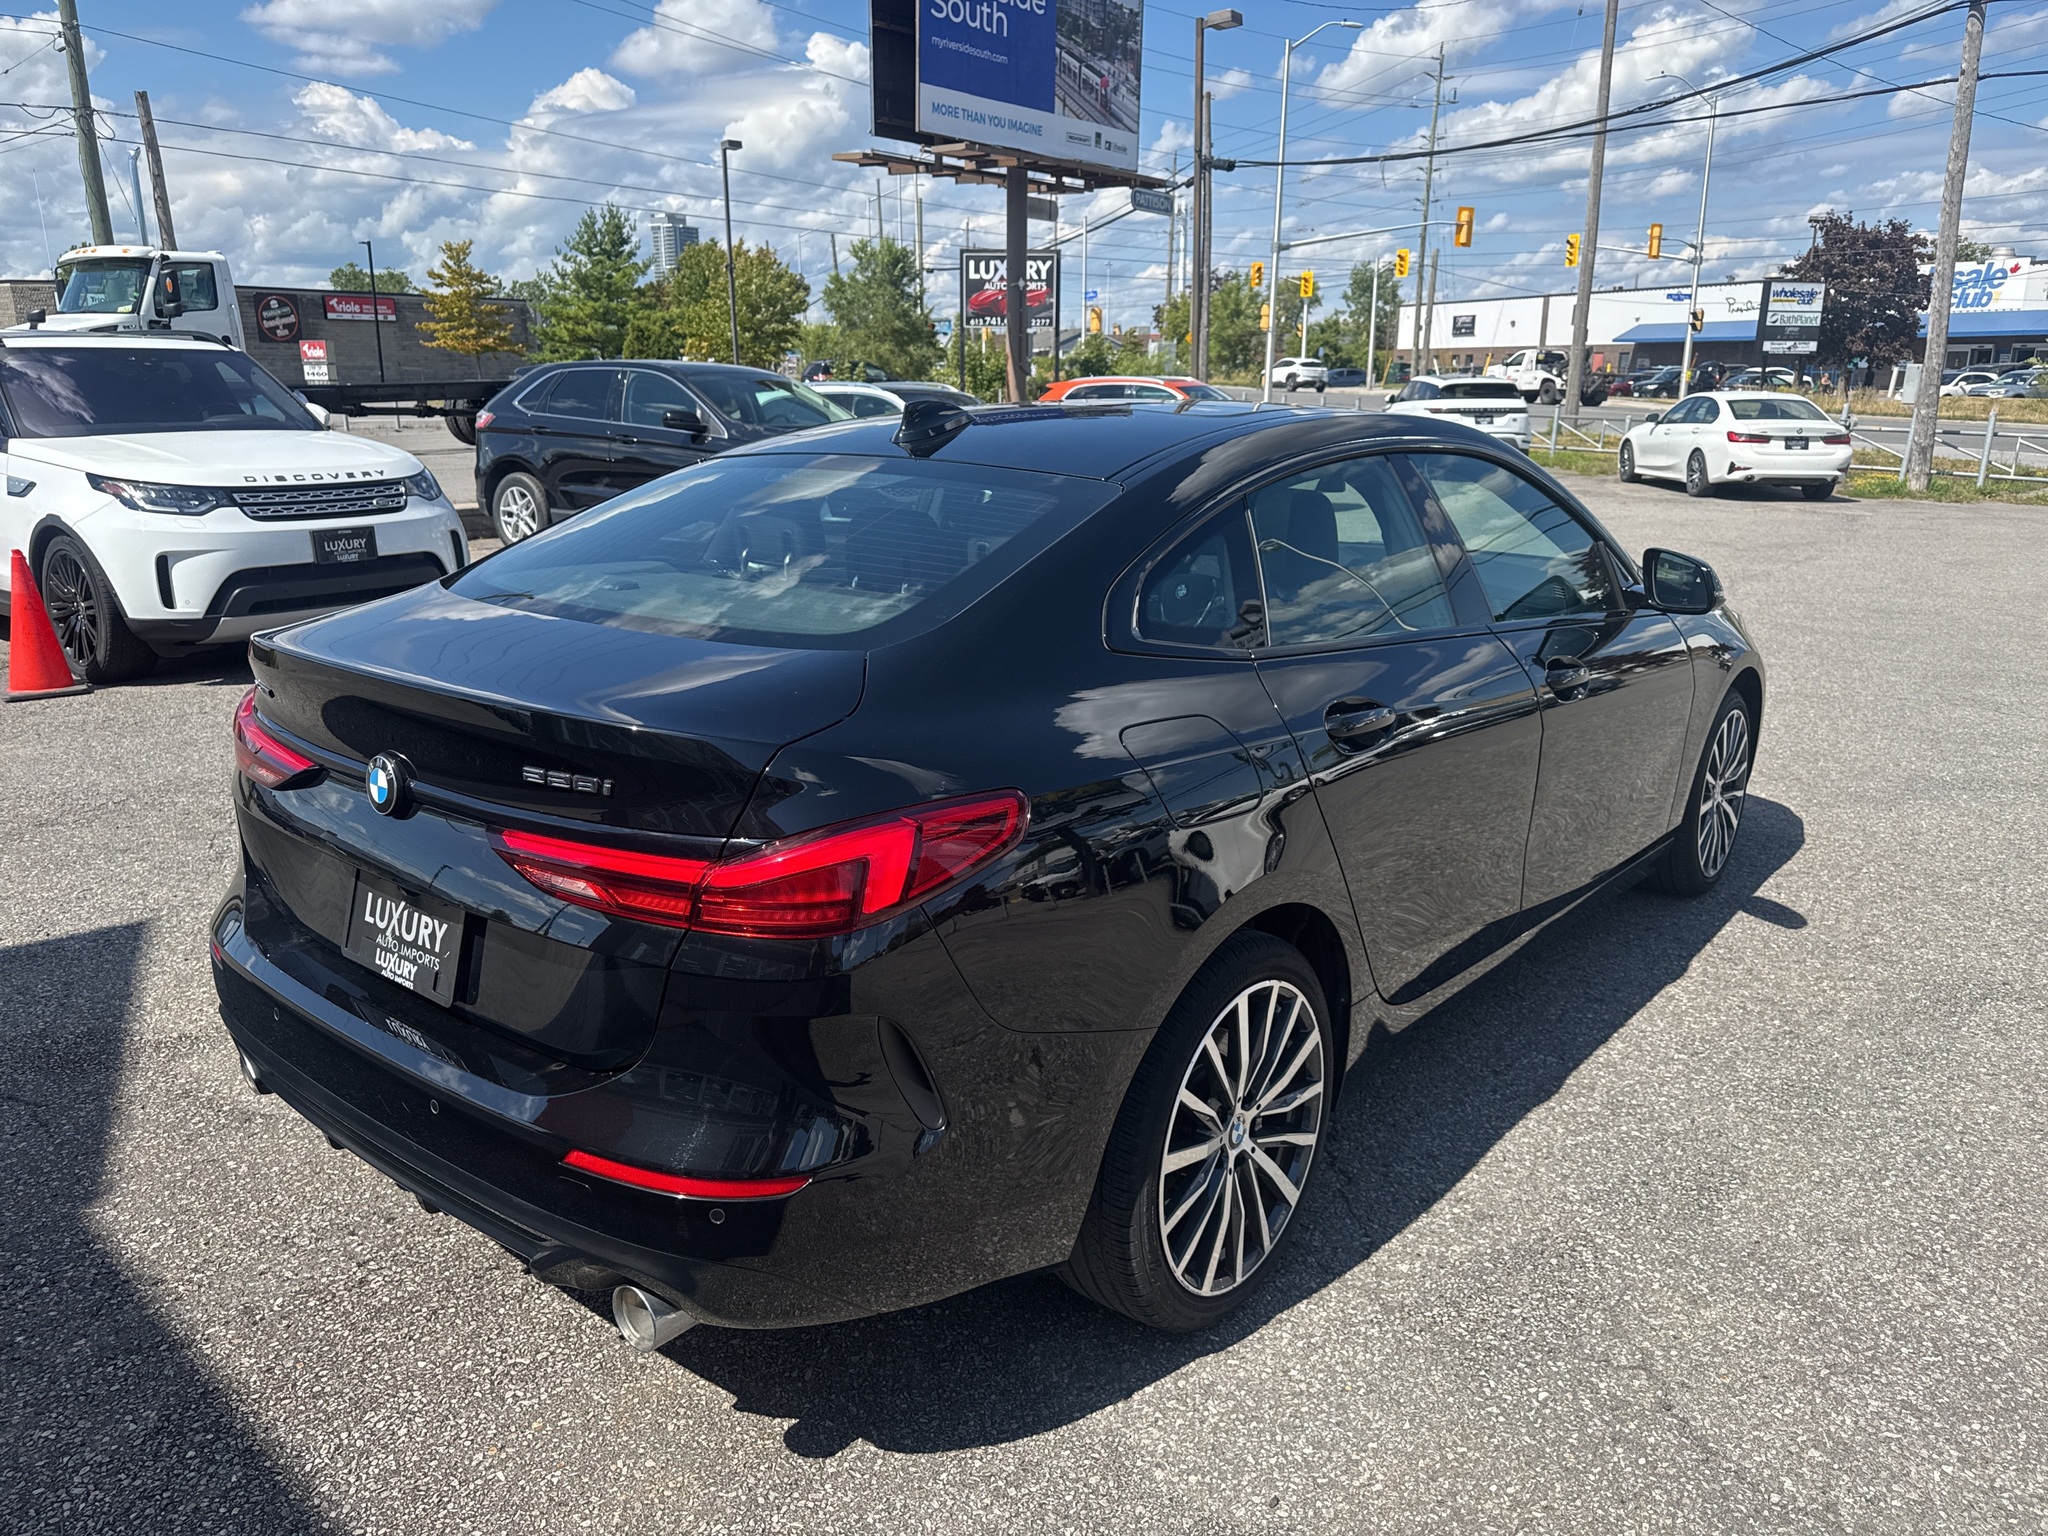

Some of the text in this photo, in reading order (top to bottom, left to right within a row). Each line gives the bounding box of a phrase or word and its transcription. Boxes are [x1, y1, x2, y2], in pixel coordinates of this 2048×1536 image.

[930, 0, 1008, 37] South
[931, 37, 1008, 64] myriversidesouth.com
[932, 102, 1043, 136] MORE THAN YOU IMAGINE
[1135, 192, 1171, 211] PATTISON
[969, 260, 1052, 282] LUXRY
[1952, 262, 2009, 290] sale
[1772, 287, 1817, 299] wholesale
[329, 298, 361, 313] Triole
[1780, 314, 1818, 325] BathPlanet
[303, 343, 325, 358] Triole
[243, 469, 385, 483] DISCOVERY
[324, 538, 367, 552] LUXURY
[522, 765, 613, 796] 228i
[364, 891, 449, 953] LUXURY
[376, 933, 440, 971] AUTO IMPORTS
[375, 947, 418, 981] LUXURY
[381, 969, 414, 990] AUTO IMPORTS
